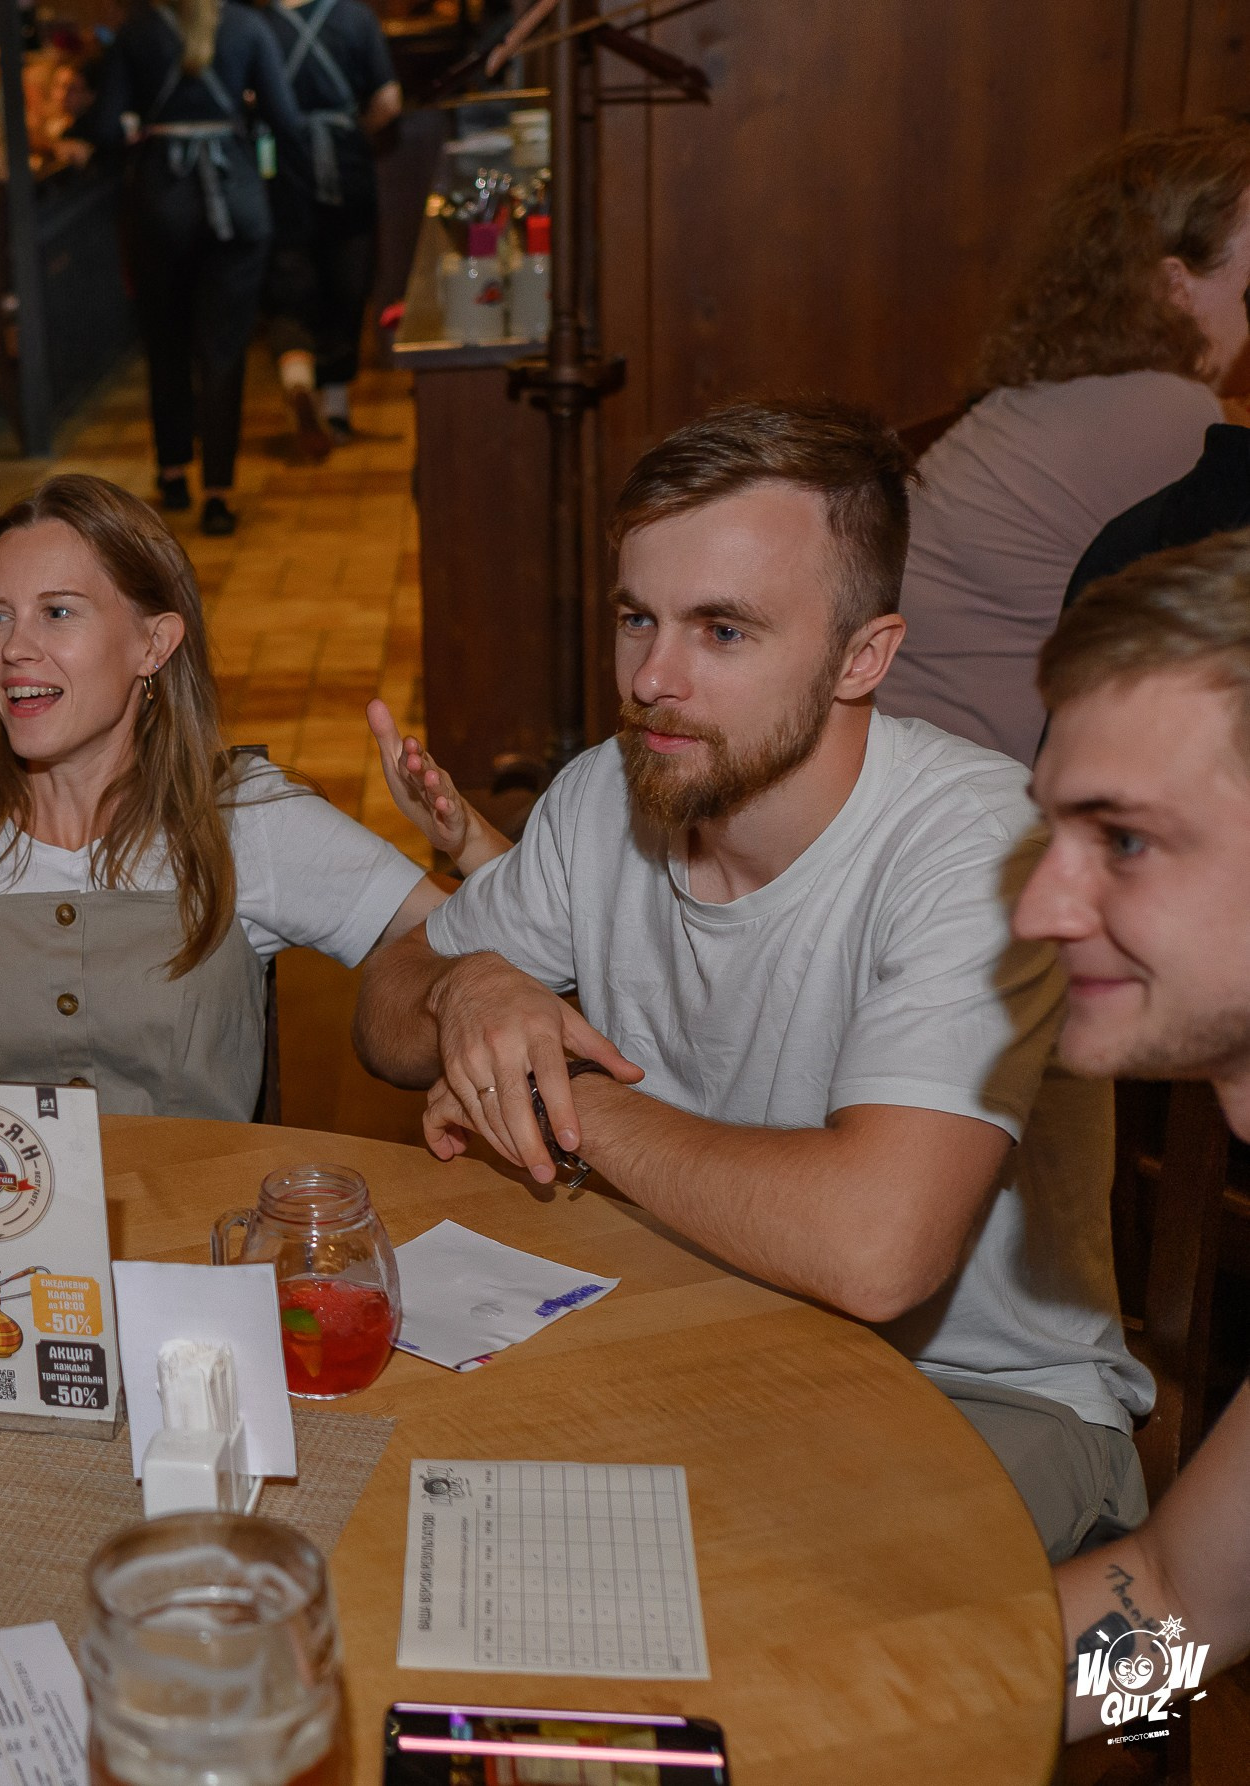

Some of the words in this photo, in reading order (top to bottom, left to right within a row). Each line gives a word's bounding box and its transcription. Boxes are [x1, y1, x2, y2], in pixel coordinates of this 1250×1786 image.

[39, 1098, 55, 1111] #1
[40, 1279, 89, 1290] ЕЖЕДНЕВНО
[47, 1291, 84, 1301] КАЛЬЯН
[58, 1301, 85, 1310] 18:00
[45, 1312, 92, 1335] -50%
[49, 1346, 93, 1362] АКЦИЯ
[54, 1362, 90, 1373] каждый
[41, 1371, 71, 1383] третий
[72, 1374, 103, 1384] кальян
[51, 1385, 98, 1407] -50%
[420, 1571, 434, 1603] ВЕРСИЯ
[419, 1606, 432, 1631] ВАША
